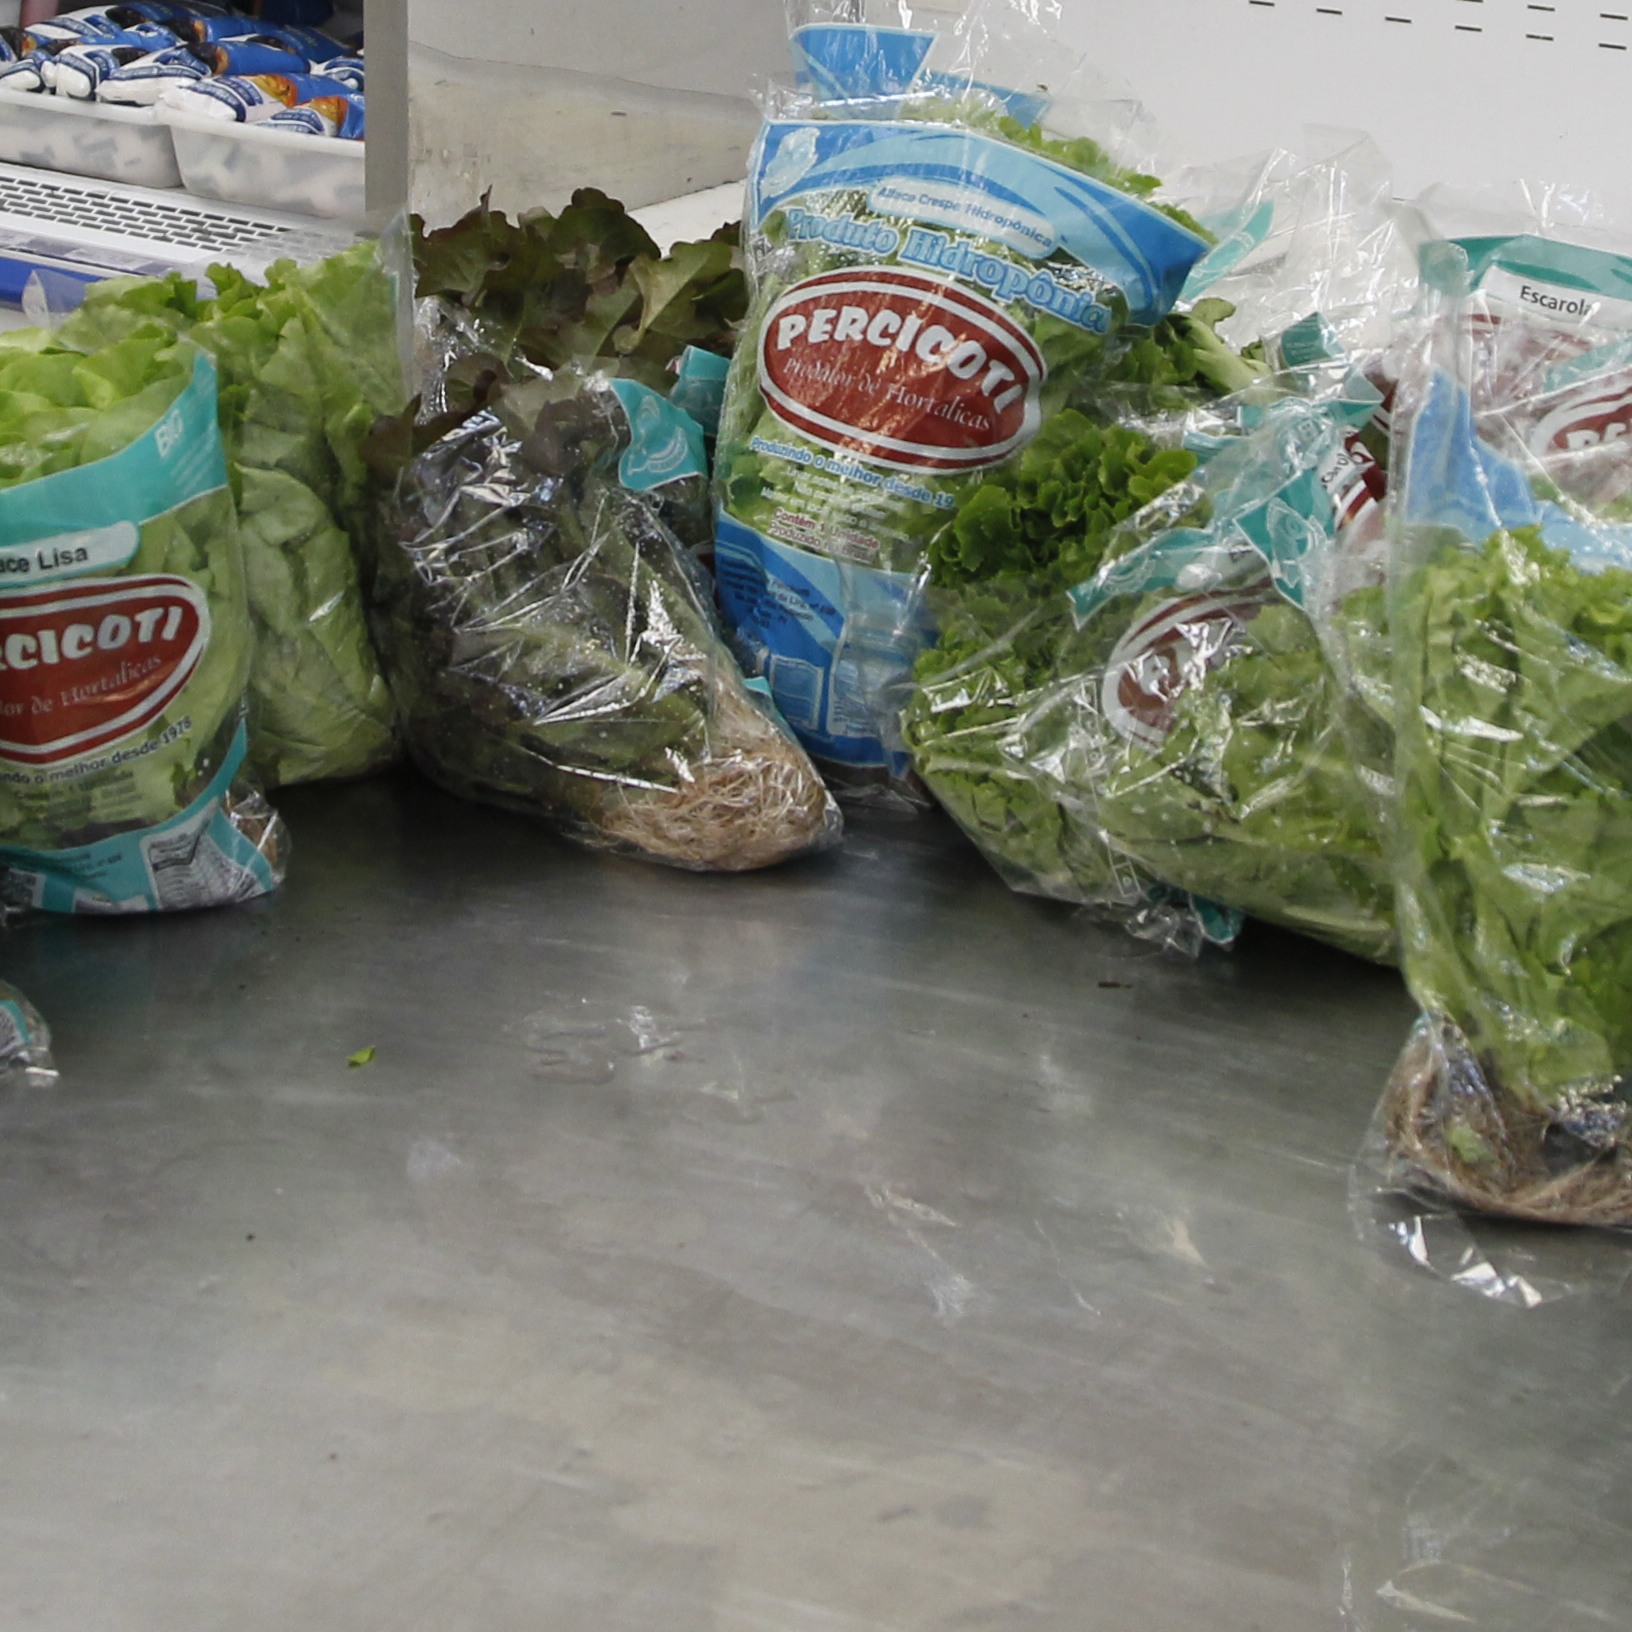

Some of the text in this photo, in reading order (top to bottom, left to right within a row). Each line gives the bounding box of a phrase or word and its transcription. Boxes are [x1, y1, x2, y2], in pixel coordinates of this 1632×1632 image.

[787, 207, 901, 256] Produto
[876, 185, 1053, 249] Alface Crespa Hidropônica
[776, 305, 1026, 416] PERCICOTI
[783, 356, 855, 389] Produtor
[859, 368, 882, 397] de
[749, 435, 812, 466] Produzindo
[814, 454, 825, 468] o
[827, 458, 882, 488] melhor
[883, 475, 931, 503] desde
[933, 490, 955, 510] 19
[773, 506, 817, 528] Contém
[829, 524, 881, 551] Unidade
[38, 546, 89, 570] Lisa
[49, 755, 107, 782] melhor
[111, 741, 158, 767] desde
[161, 715, 193, 746] 1978
